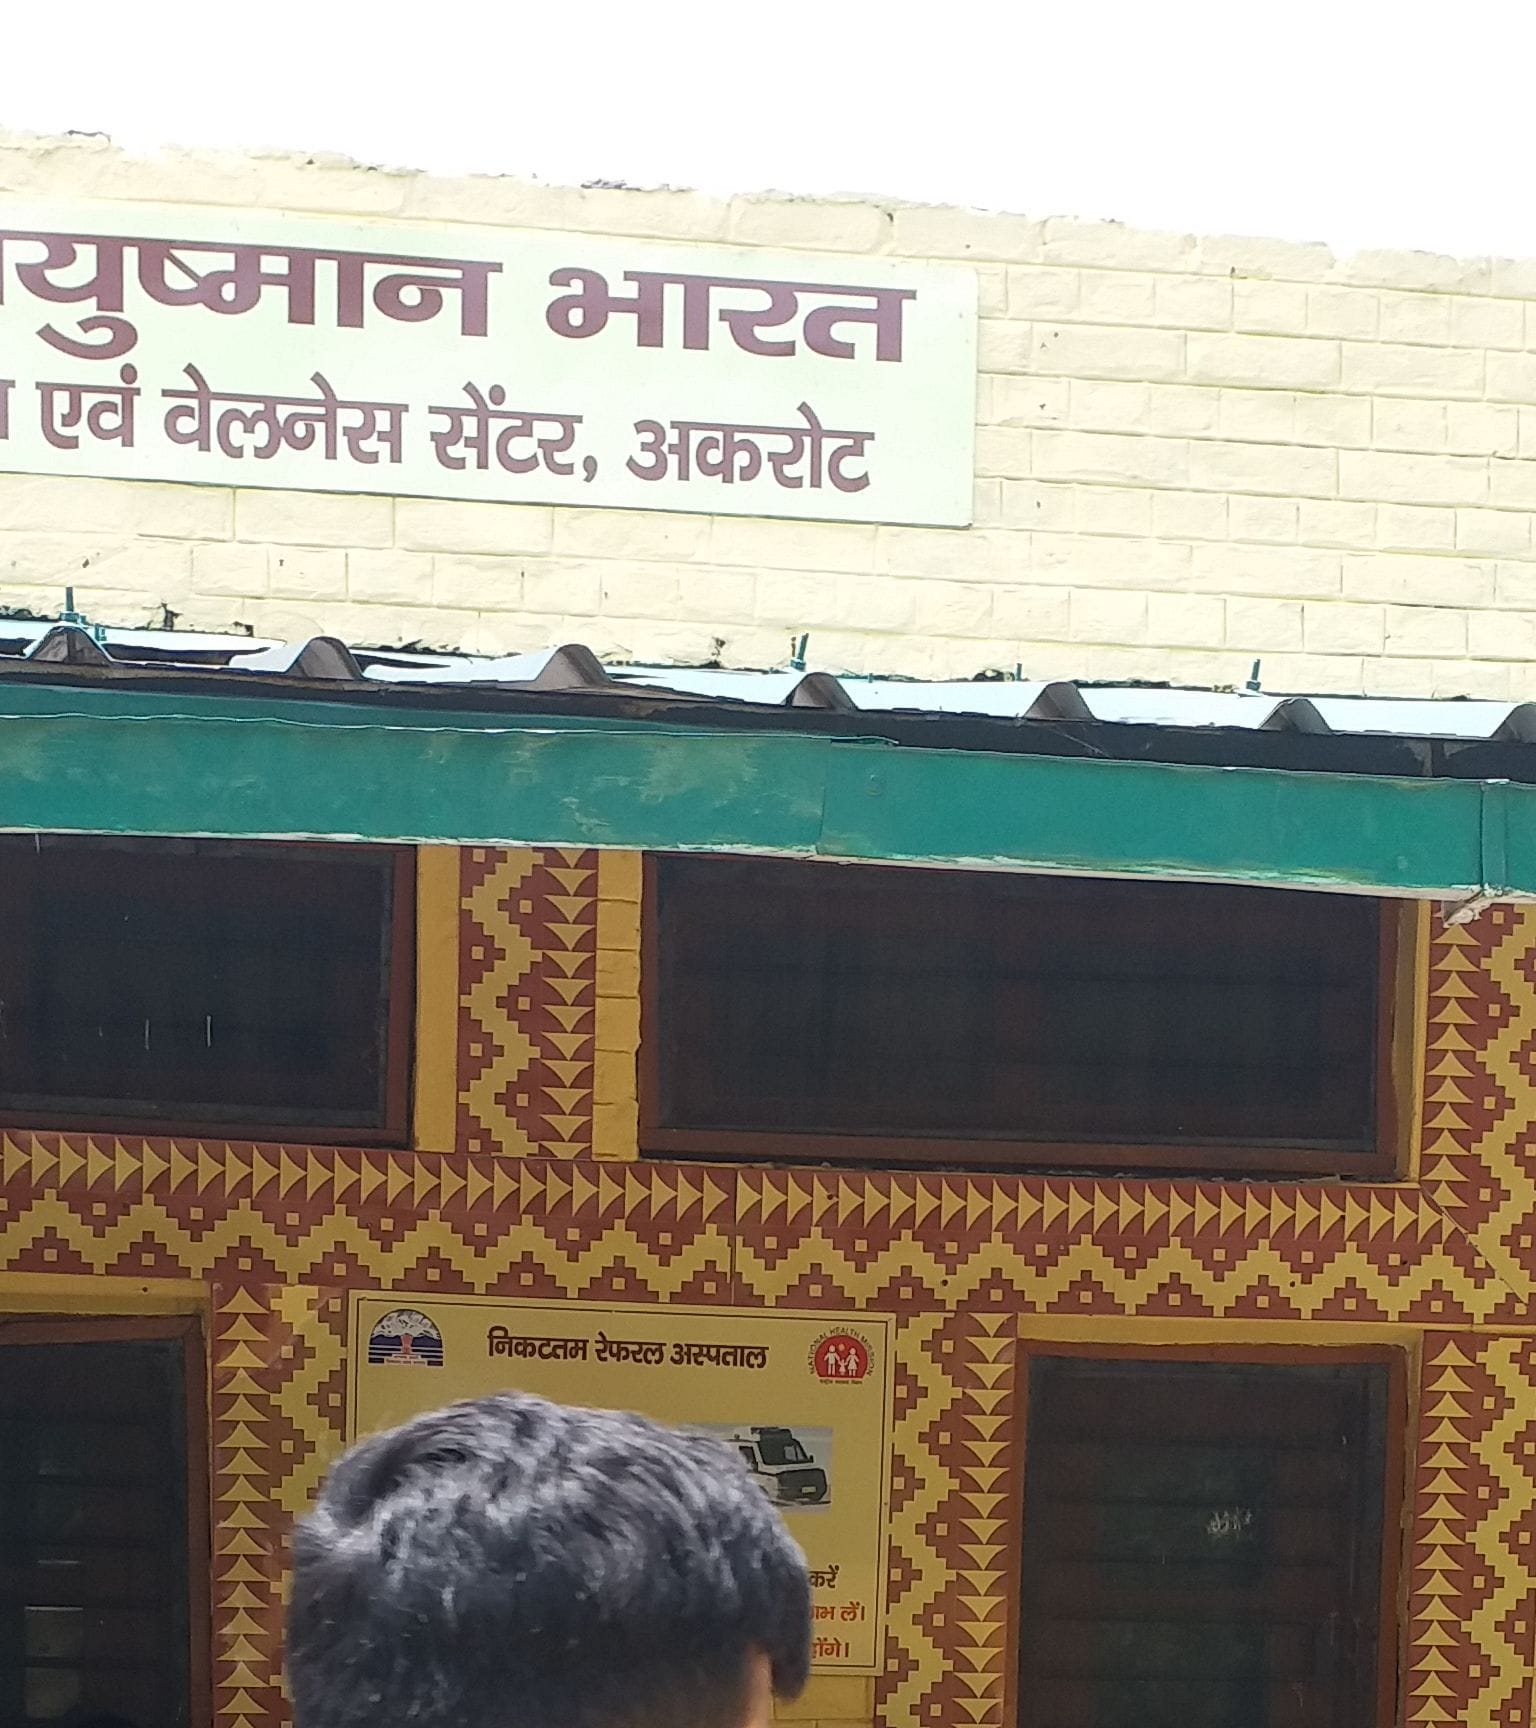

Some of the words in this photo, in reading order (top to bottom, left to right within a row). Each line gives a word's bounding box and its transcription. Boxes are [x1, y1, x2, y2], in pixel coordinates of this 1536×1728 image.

[545, 267, 917, 363] भारत
[36, 363, 141, 449] एवं
[162, 364, 408, 464] वेलनेस
[429, 380, 598, 484] सेंटर,
[626, 401, 875, 492] अकरोट
[487, 1326, 588, 1361] निकटतम
[595, 1331, 667, 1364] रेफरल
[670, 1343, 769, 1368] अस्पताल
[809, 1564, 839, 1589] करें
[810, 1605, 835, 1620] ाभ
